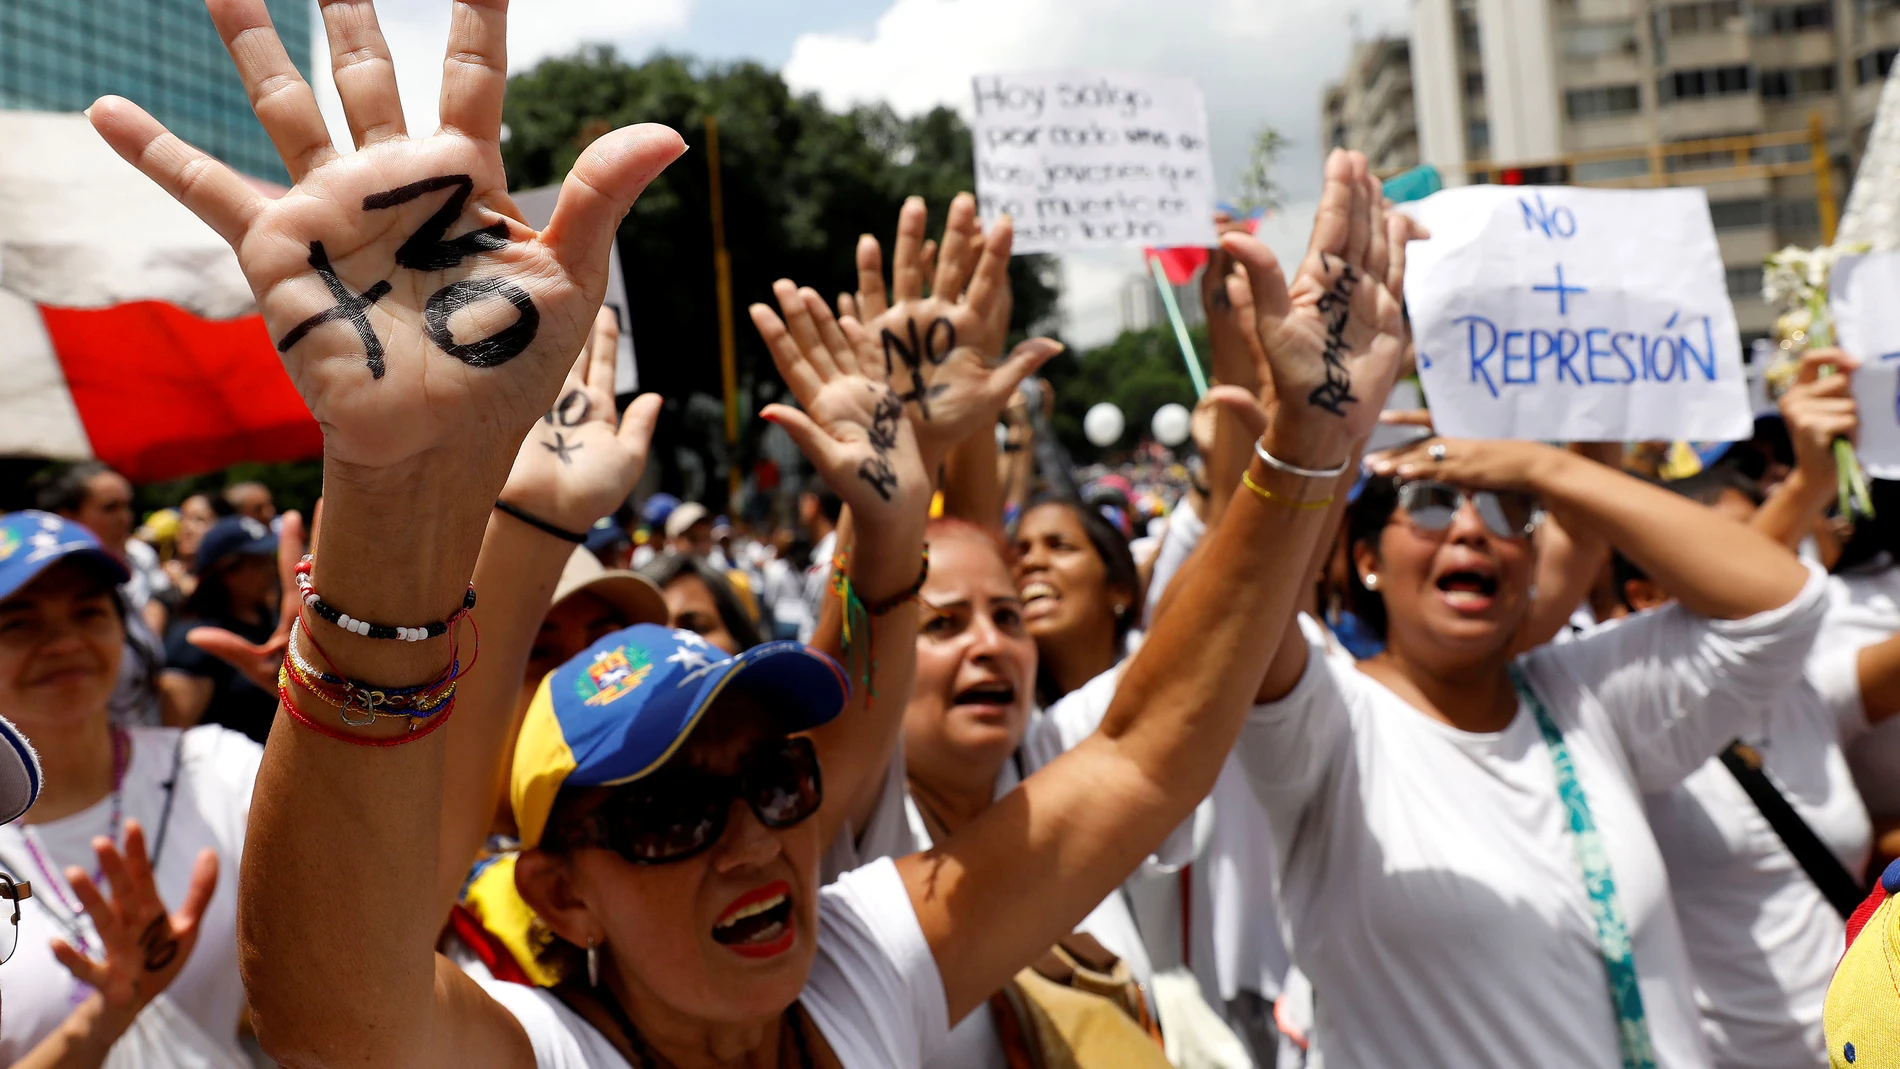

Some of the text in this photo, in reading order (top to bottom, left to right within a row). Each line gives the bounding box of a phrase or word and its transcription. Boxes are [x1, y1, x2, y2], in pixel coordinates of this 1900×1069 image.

[973, 75, 1046, 120] Hoy
[1532, 263, 1588, 316] +
[881, 316, 956, 376] NO
[1453, 311, 1719, 399] REPRESIÓN
